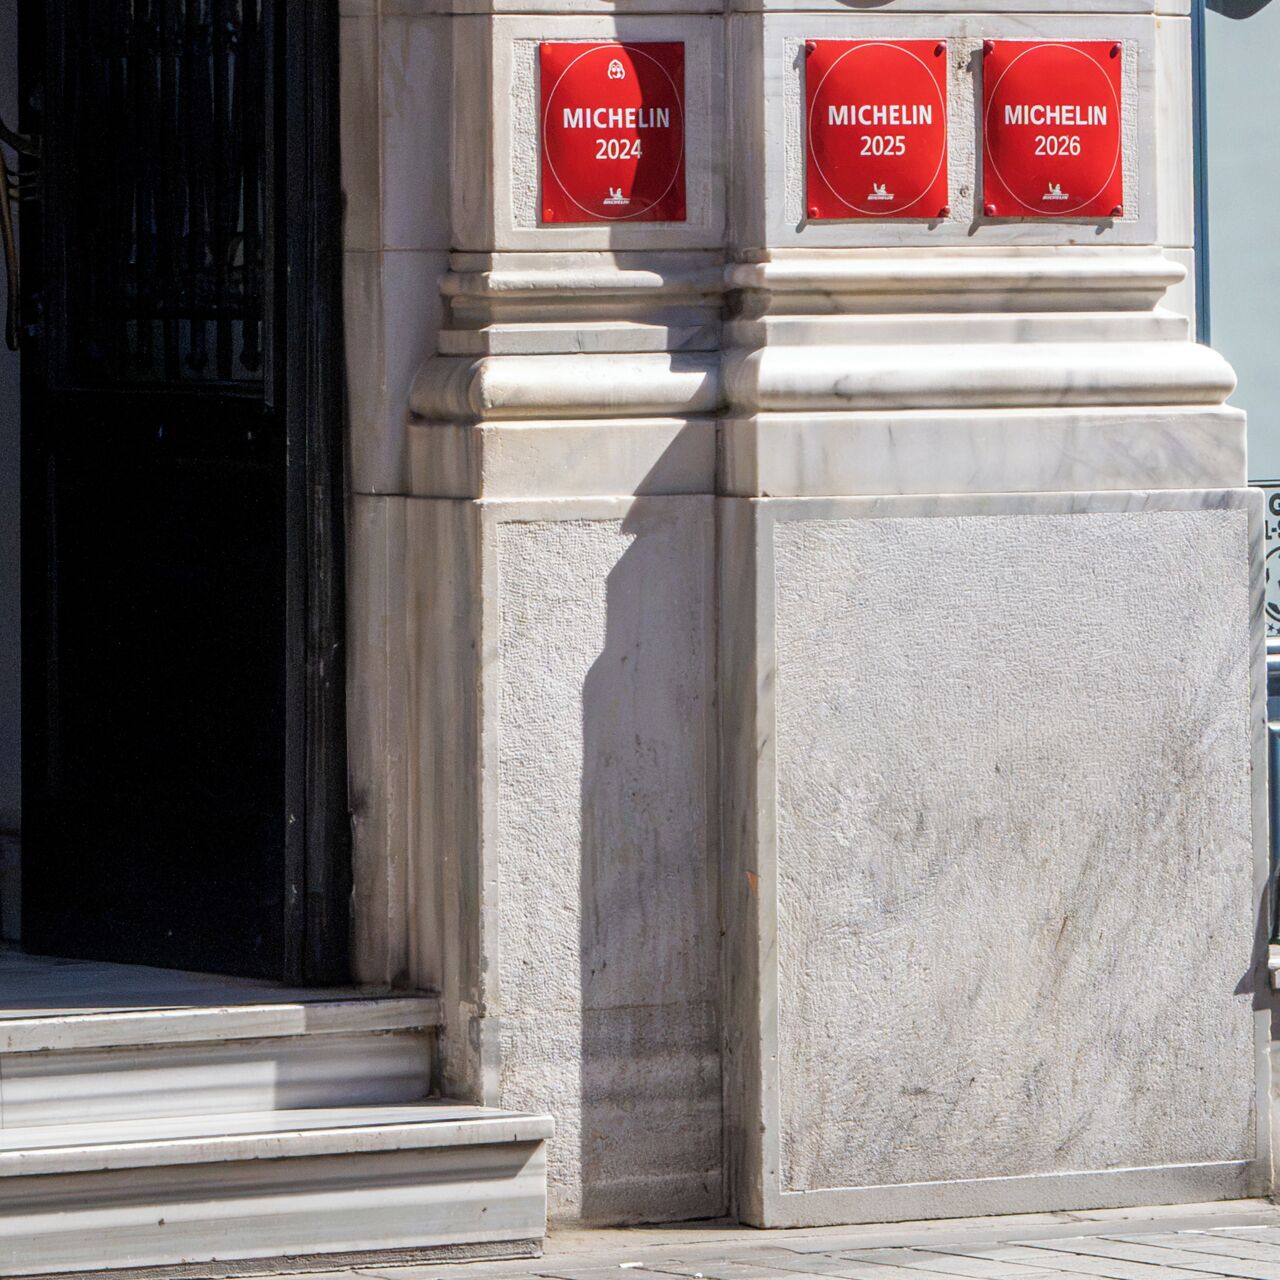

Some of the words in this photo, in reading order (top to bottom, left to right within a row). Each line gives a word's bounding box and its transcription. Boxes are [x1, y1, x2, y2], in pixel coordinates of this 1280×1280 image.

[562, 107, 670, 129] MICHELIN
[827, 104, 933, 126] MICHELIN
[1004, 104, 1108, 126] MICHELIN
[595, 138, 642, 160] 2024
[859, 135, 906, 156] 2025
[1034, 135, 1081, 156] 2026
